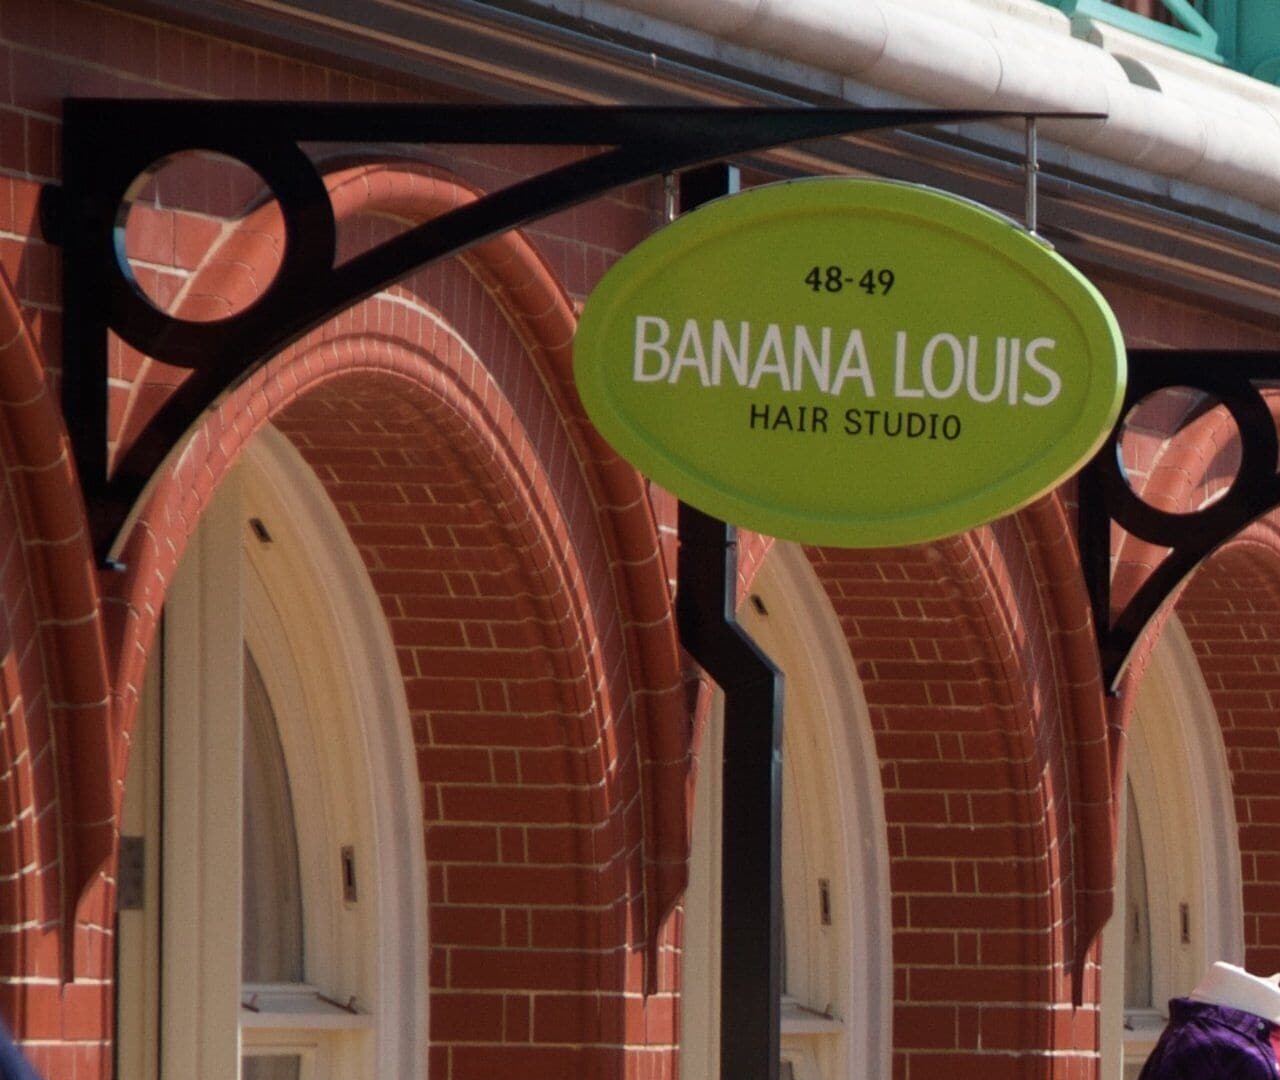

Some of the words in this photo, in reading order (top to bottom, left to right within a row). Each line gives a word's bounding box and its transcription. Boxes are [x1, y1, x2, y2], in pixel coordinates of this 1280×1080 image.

[804, 266, 895, 296] 48-49
[632, 315, 877, 398] BANANA
[894, 330, 1063, 407] LOUIS
[749, 404, 829, 433] HAIR
[844, 409, 962, 441] STUDIO
